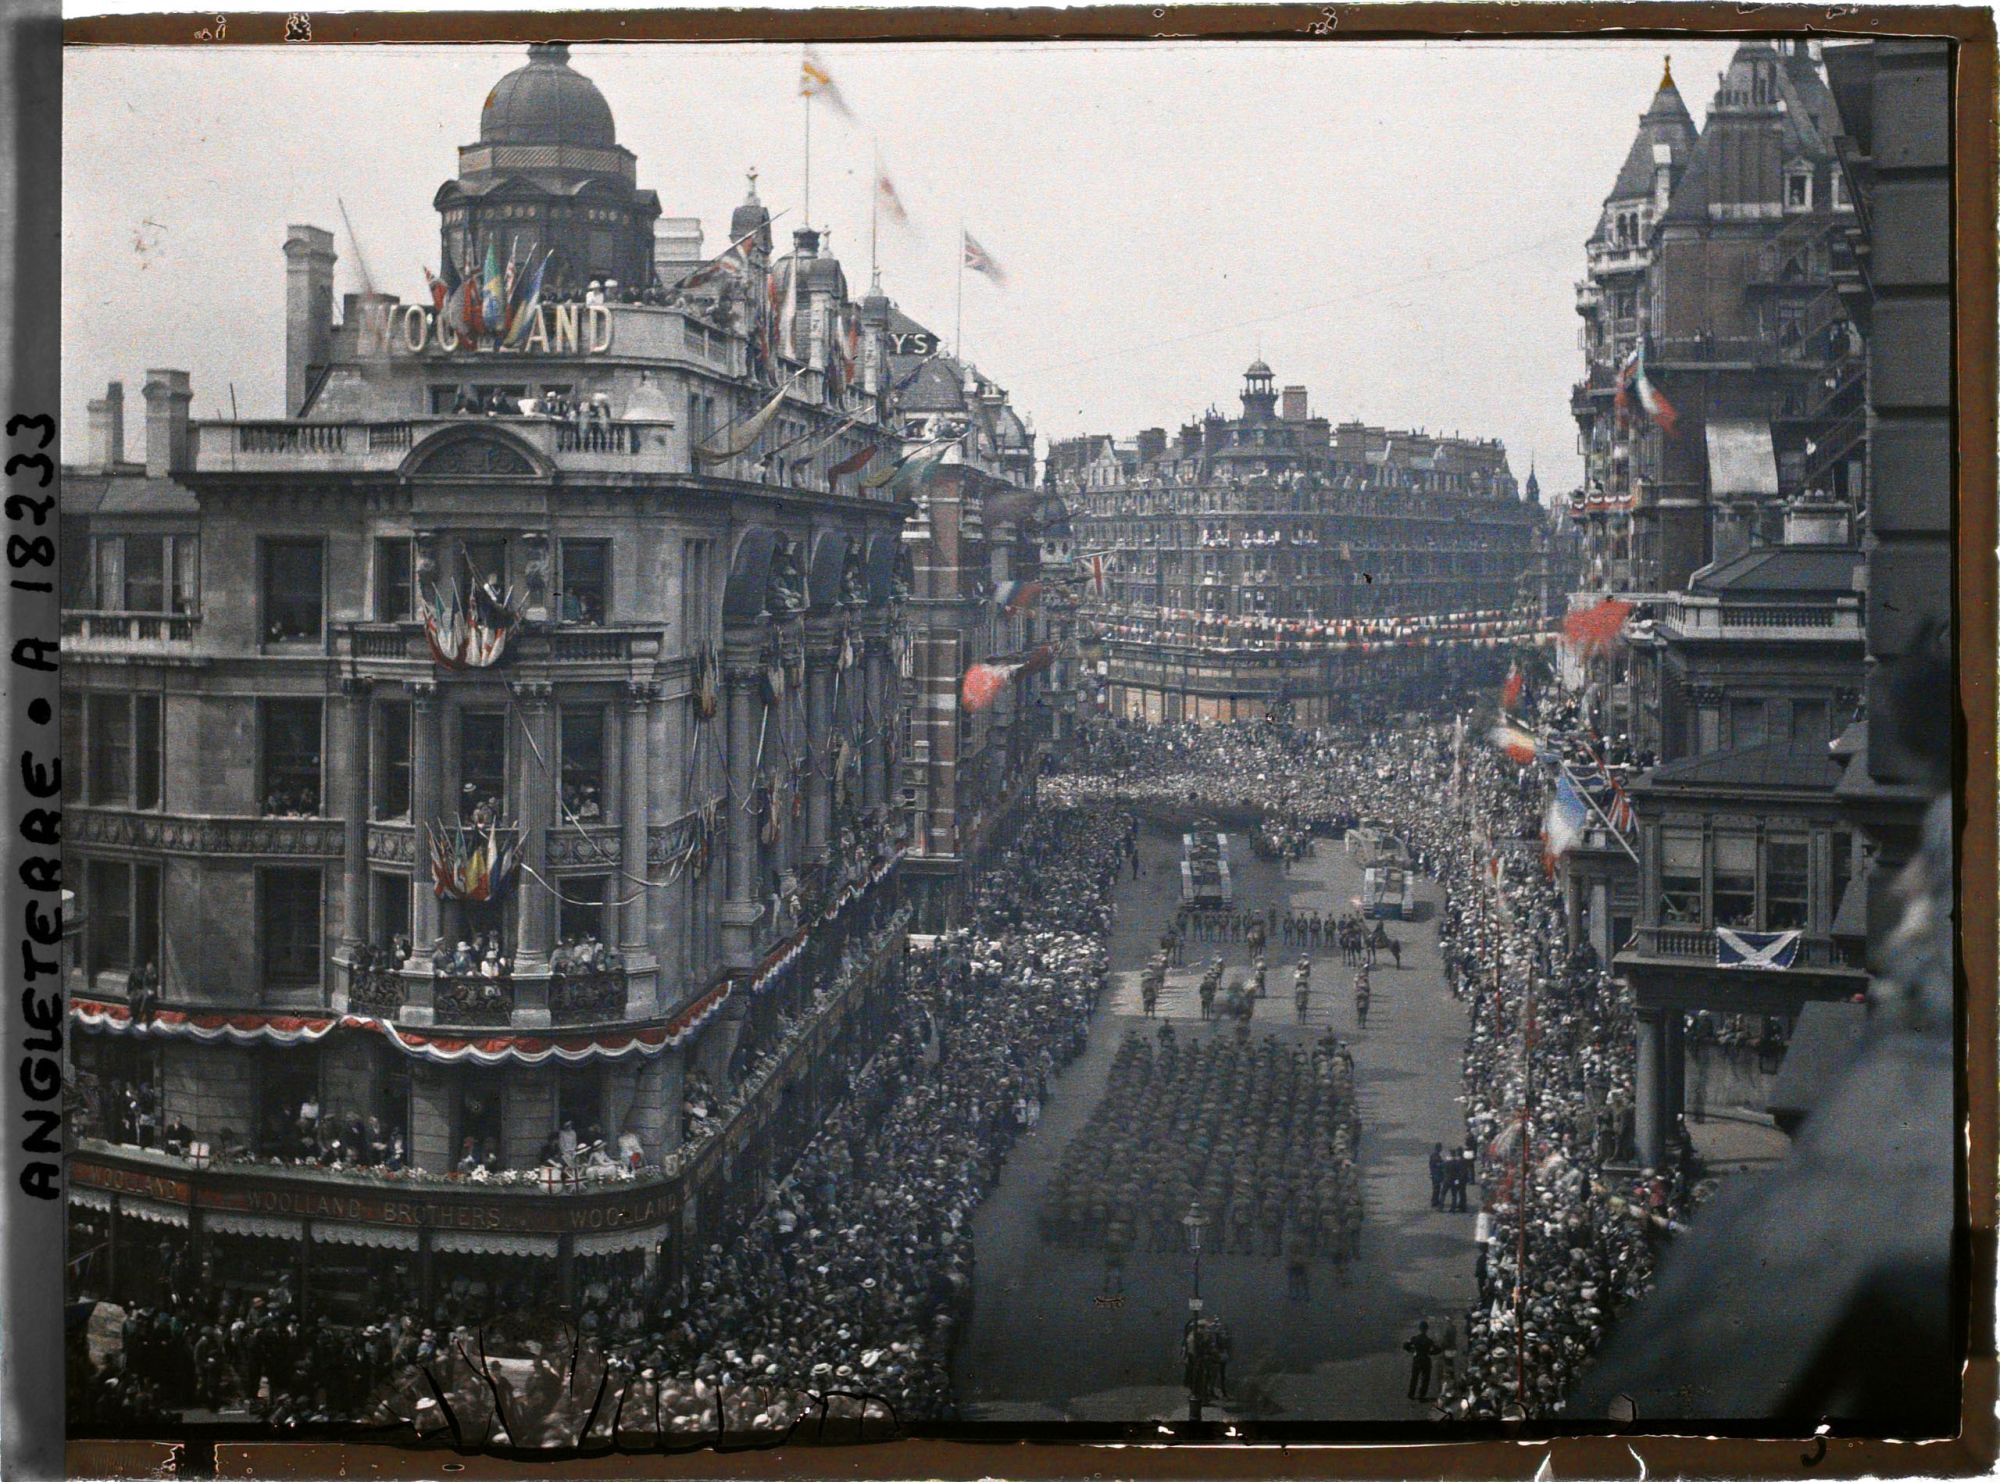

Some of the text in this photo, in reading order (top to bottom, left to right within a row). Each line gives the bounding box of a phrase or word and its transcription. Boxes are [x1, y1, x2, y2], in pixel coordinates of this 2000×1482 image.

[362, 303, 613, 352] WOOAND
[248, 1191, 500, 1228] WOOLLAND BROTHERS
